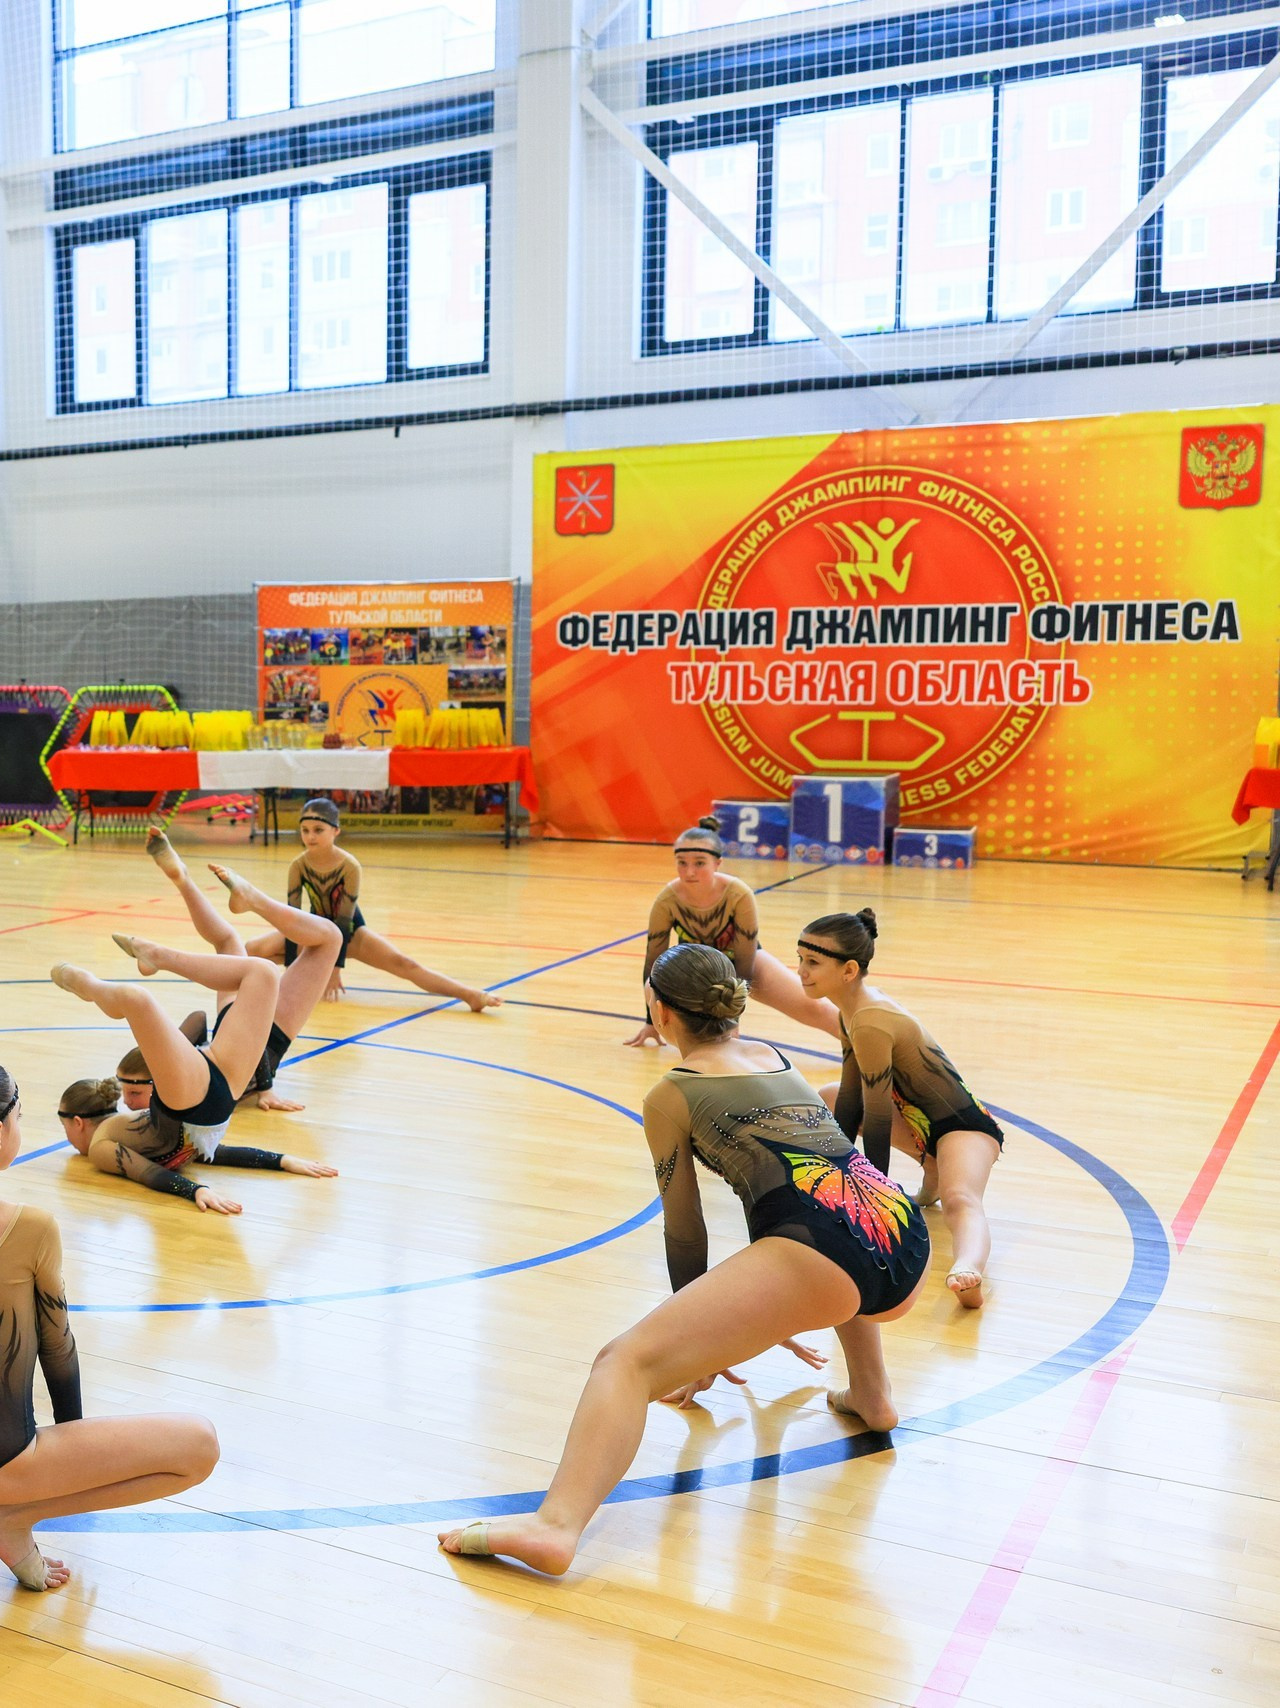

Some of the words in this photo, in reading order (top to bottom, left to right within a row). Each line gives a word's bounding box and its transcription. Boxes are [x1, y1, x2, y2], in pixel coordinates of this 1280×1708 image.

[707, 519, 774, 610] ДЕРАЦИЯ
[775, 475, 912, 527] ДЖАМПИНГ
[917, 480, 1017, 547] ФИТНЕСА
[1011, 544, 1050, 606] РОСС
[557, 609, 777, 654] ФЕДЕРАЦИЯ
[784, 604, 1019, 653] ДЖАМПИНГ
[1030, 600, 1241, 645] ФИТНЕСА
[668, 661, 876, 704] ТУЛЬСКАЯ
[886, 660, 1093, 704] ОБЛАСТЬ
[954, 696, 1040, 785] FEDERAT
[738, 807, 760, 843] 2
[823, 783, 843, 843] 1
[924, 834, 939, 856] 3
